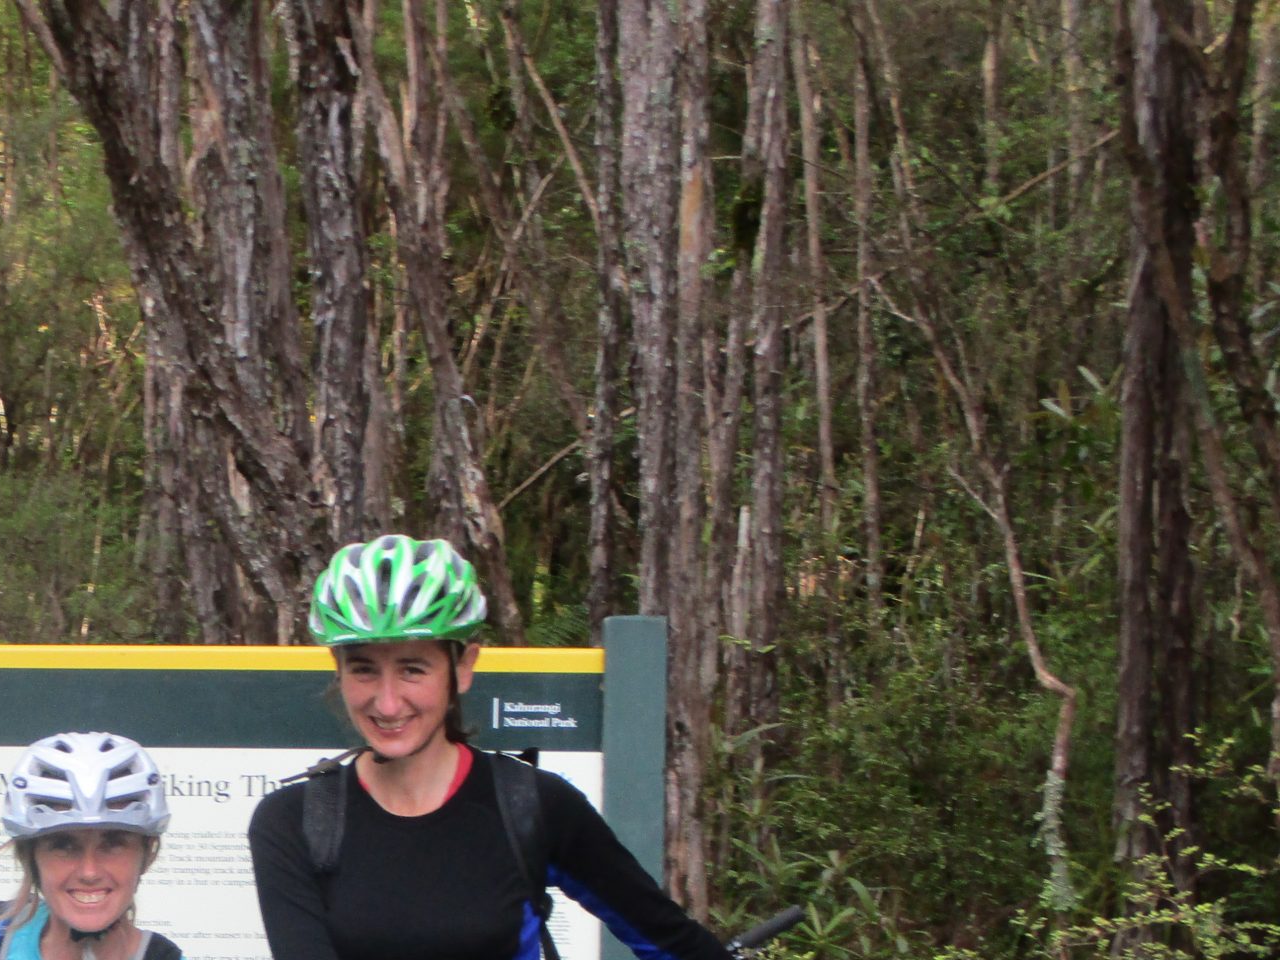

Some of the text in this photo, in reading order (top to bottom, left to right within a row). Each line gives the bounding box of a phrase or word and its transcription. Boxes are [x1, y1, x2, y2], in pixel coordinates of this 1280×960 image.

[503, 717, 578, 728] National Park
[162, 774, 232, 803] iking
